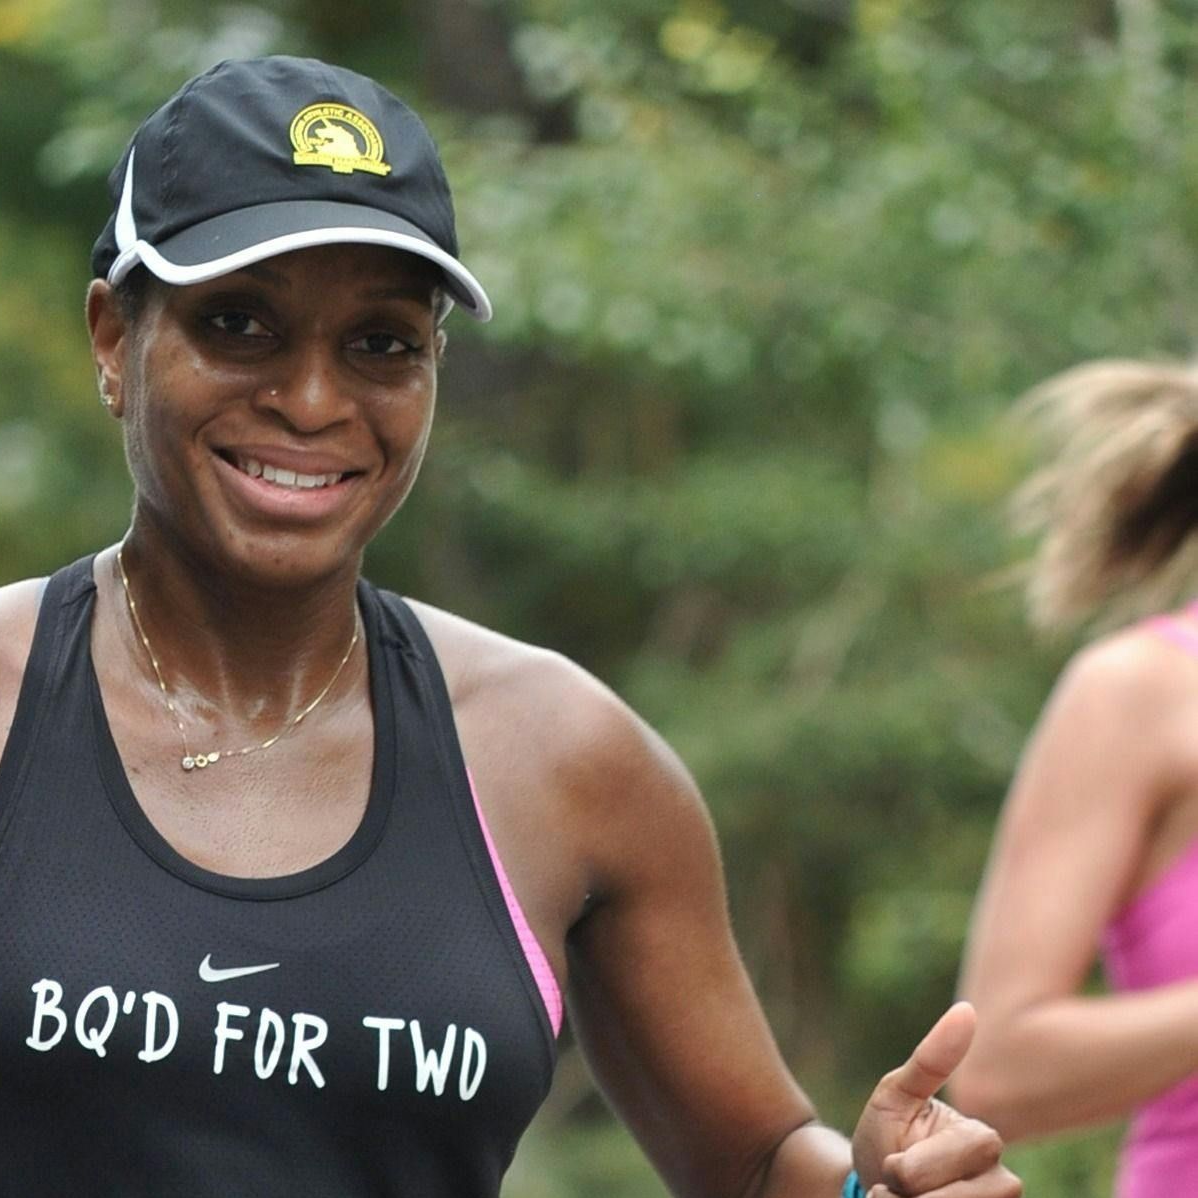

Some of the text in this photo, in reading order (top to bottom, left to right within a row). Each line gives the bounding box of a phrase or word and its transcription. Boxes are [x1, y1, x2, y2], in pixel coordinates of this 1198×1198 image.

[25, 978, 179, 1062] BQ'D
[213, 1001, 328, 1088] FOR
[362, 1016, 487, 1101] TWO
